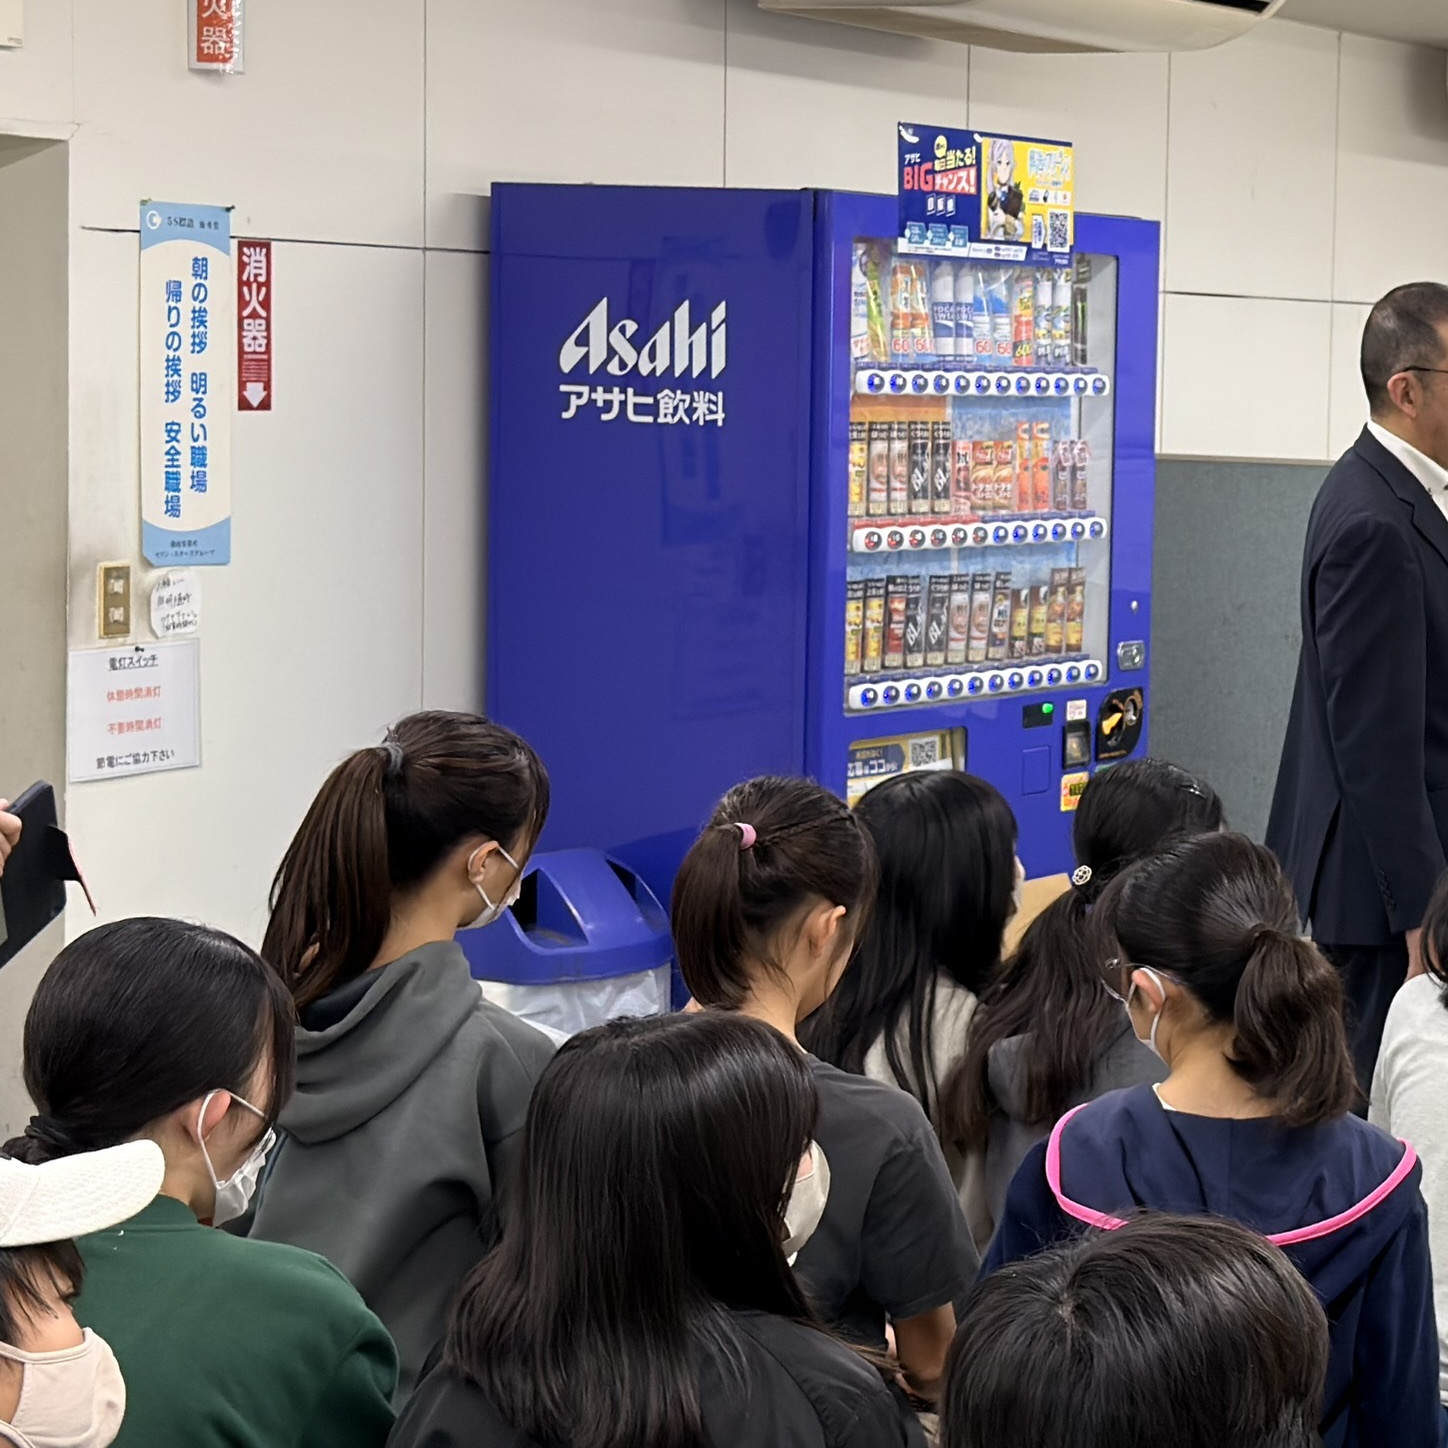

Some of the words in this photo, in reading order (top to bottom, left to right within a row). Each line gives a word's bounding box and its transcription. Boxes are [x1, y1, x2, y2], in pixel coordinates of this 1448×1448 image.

[903, 161, 934, 192] BIG
[935, 168, 976, 192] チャンス!
[190, 256, 208, 355] 朝の挨拶
[242, 246, 268, 351] 消火器
[164, 279, 183, 404] 帰りの挨拶
[559, 296, 727, 379] Asahi
[190, 371, 209, 494] 明るい職場
[558, 383, 727, 427] アサヒ飲料
[164, 421, 181, 519] 安全職場
[109, 654, 159, 671] 電灯スイッチ
[107, 686, 161, 703] 休憩時間消灯
[96, 748, 175, 770] 節電にご協力下さい
